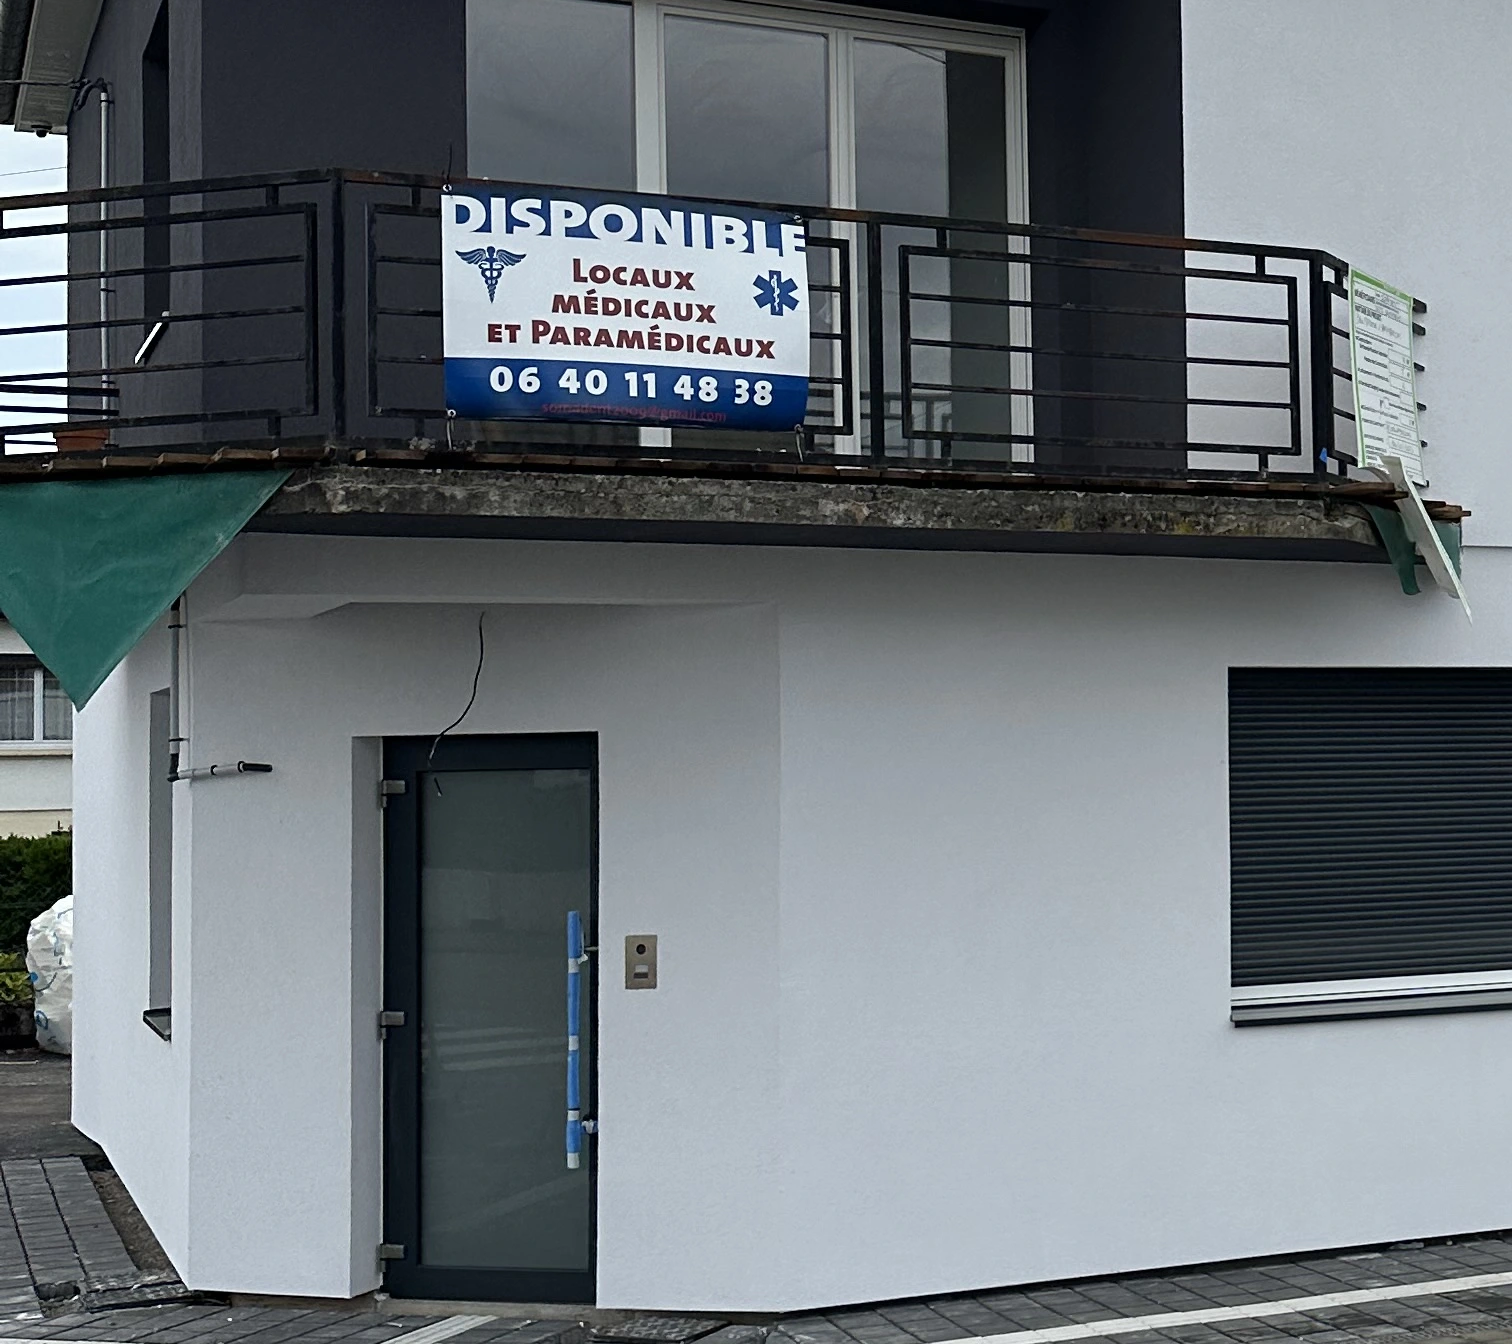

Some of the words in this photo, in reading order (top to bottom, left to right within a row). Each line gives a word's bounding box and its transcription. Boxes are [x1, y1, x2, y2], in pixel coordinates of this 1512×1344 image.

[441, 194, 806, 256] DISPONIBLE
[552, 289, 717, 324] MÉDICAUX
[489, 366, 541, 393] 06
[558, 368, 608, 396] 40
[624, 371, 657, 399] 11
[673, 374, 719, 403] 48
[733, 378, 774, 406] 38
